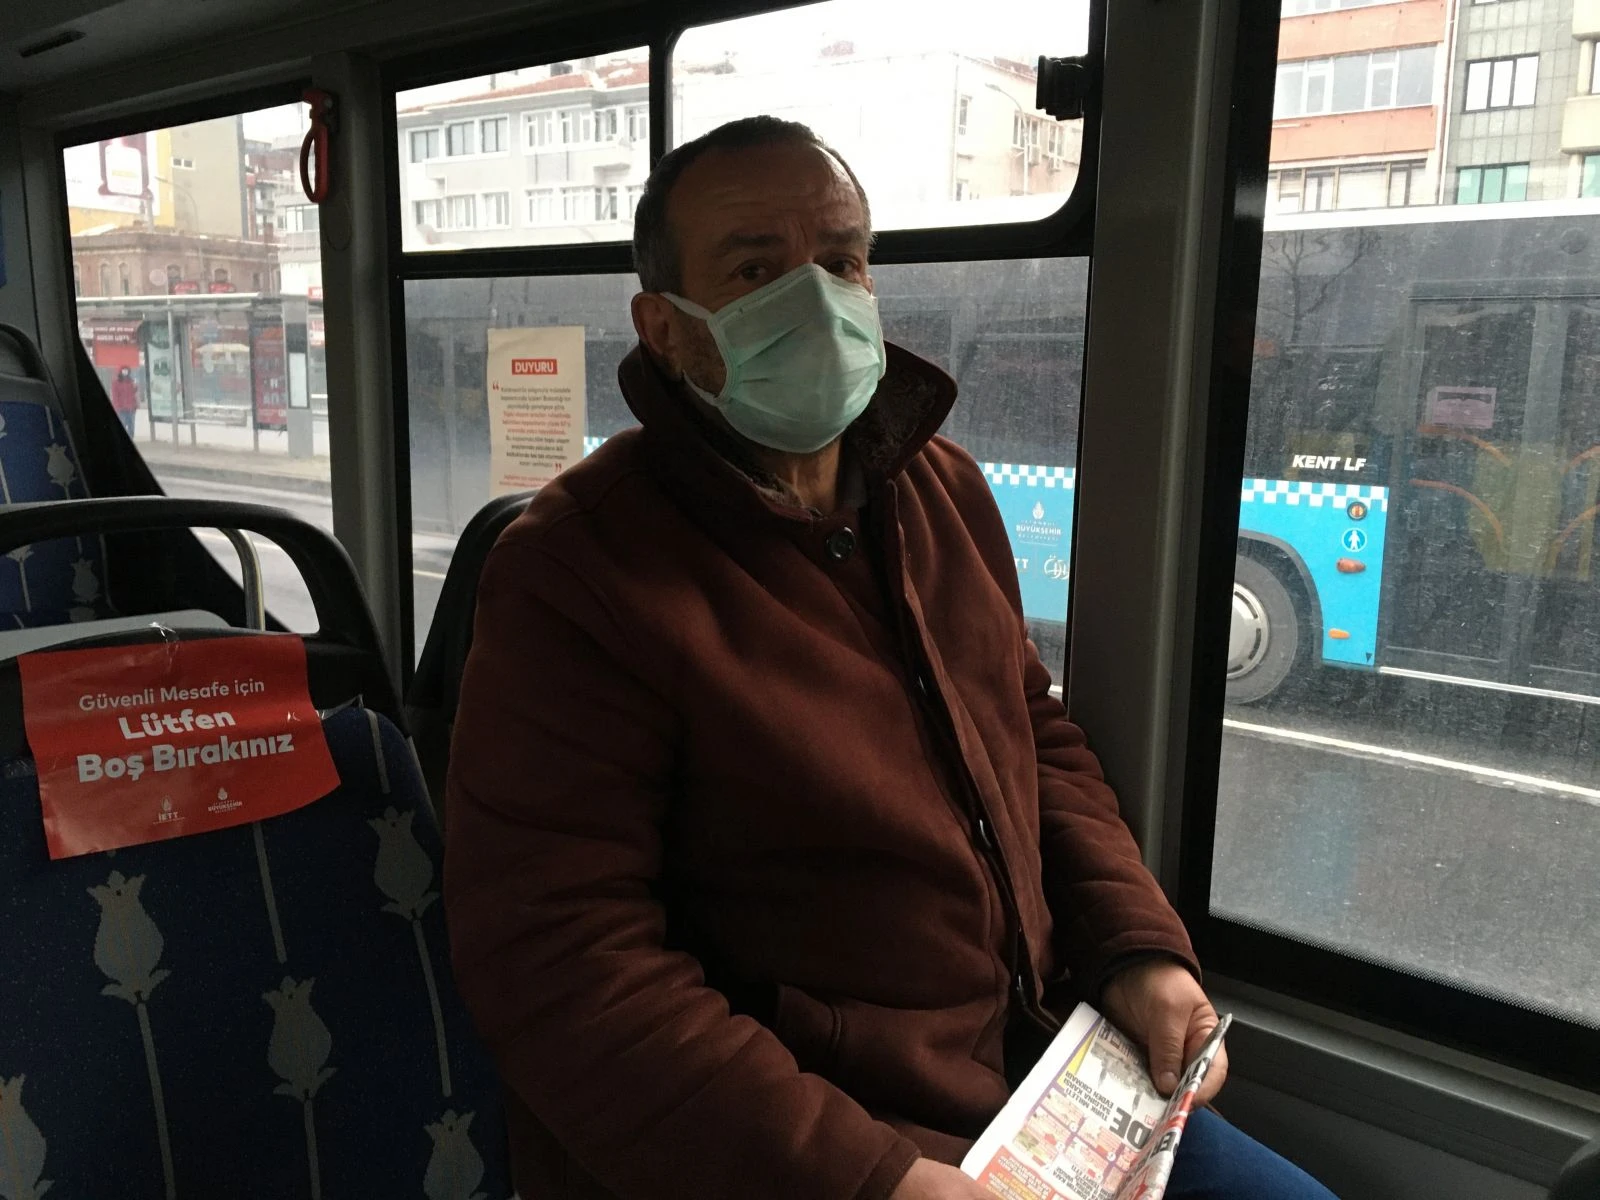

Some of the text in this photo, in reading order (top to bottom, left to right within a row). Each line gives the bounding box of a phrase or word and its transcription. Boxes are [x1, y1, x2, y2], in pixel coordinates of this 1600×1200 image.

[515, 361, 554, 373] DUYURU
[1292, 455, 1366, 471] KENT LF
[78, 678, 265, 711] Güvenli Mesafe için
[118, 708, 236, 740] Lütfen
[76, 733, 295, 784] Boş Bırakınız
